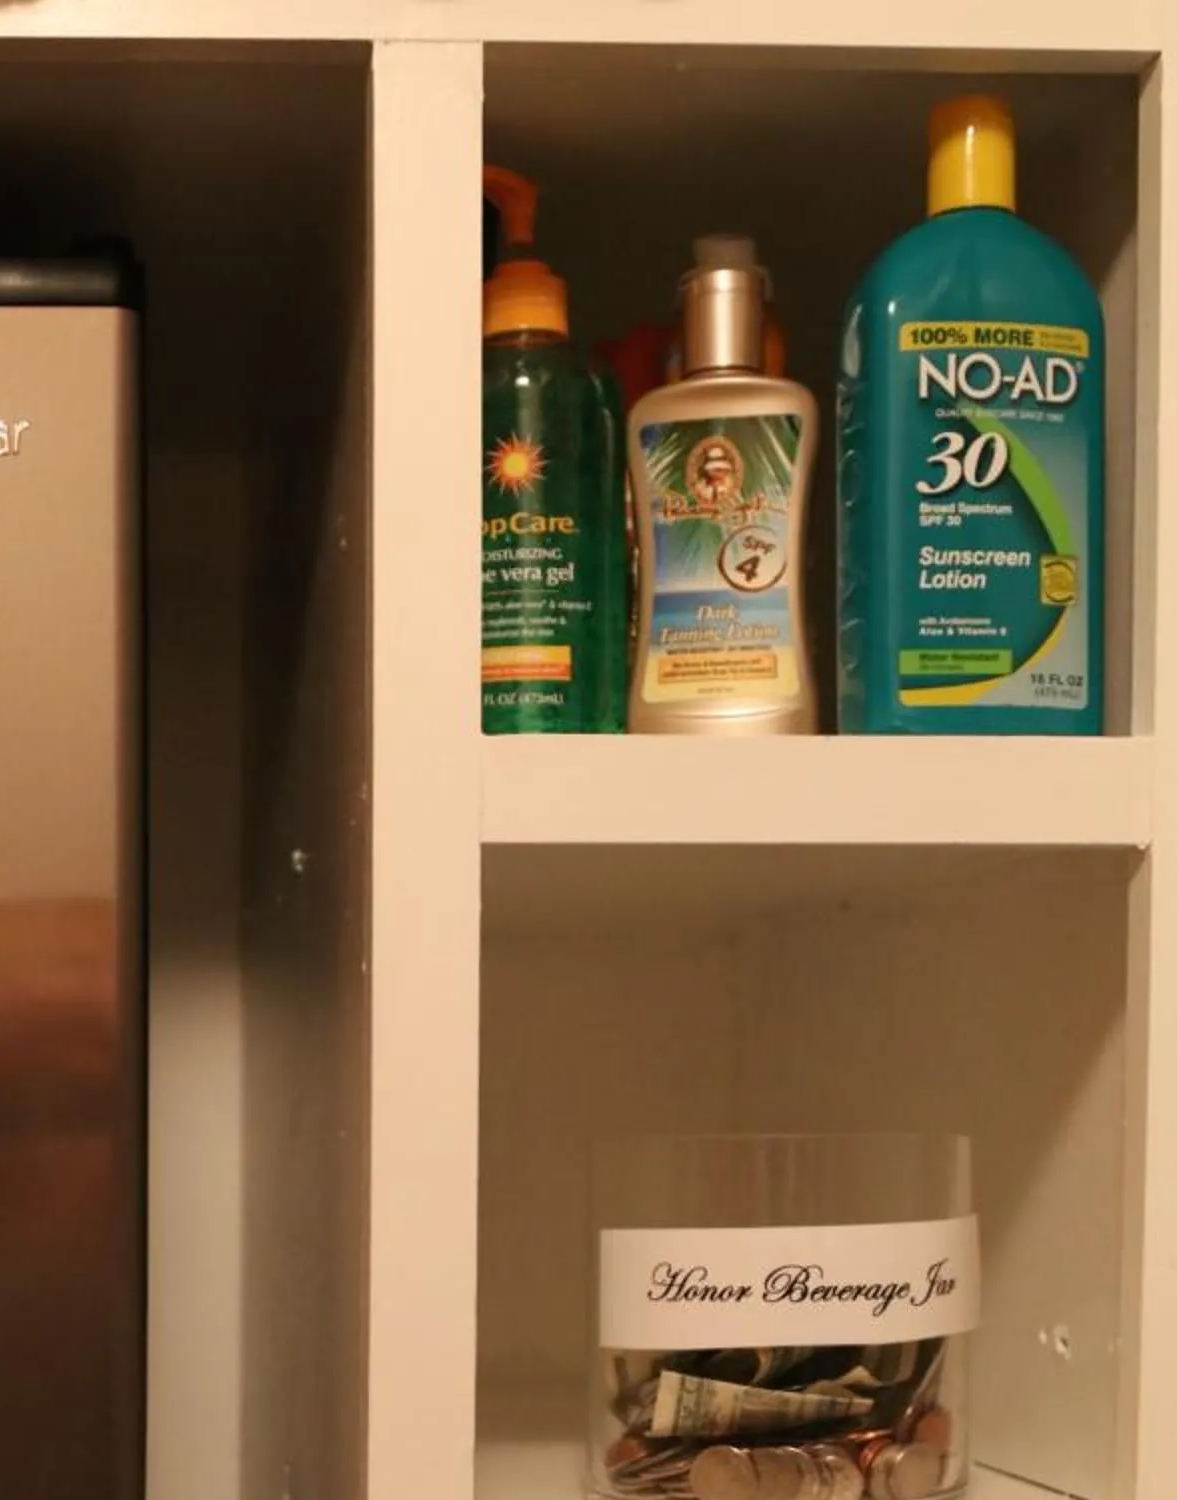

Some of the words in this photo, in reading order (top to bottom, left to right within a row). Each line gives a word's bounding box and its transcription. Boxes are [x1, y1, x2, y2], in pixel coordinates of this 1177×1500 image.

[910, 327, 968, 345] 100%
[974, 328, 1034, 346] MORE
[918, 352, 1079, 404] NO-AD
[915, 431, 1008, 495] 30
[919, 501, 956, 514] Broad
[957, 502, 1013, 517] Spectrum
[919, 514, 943, 527] SPF
[946, 515, 962, 527] 30
[482, 546, 564, 562] OISTURIZING
[743, 534, 776, 555] SPF
[919, 546, 1032, 567] Sunscreen
[500, 566, 543, 581] vera
[545, 561, 575, 587] gel
[735, 555, 761, 583] 4
[919, 570, 987, 589] Lotion
[1048, 673, 1064, 685] FL
[646, 1262, 753, 1304] Honor
[762, 1264, 911, 1317] Beverage
[909, 1257, 958, 1307] Jar
